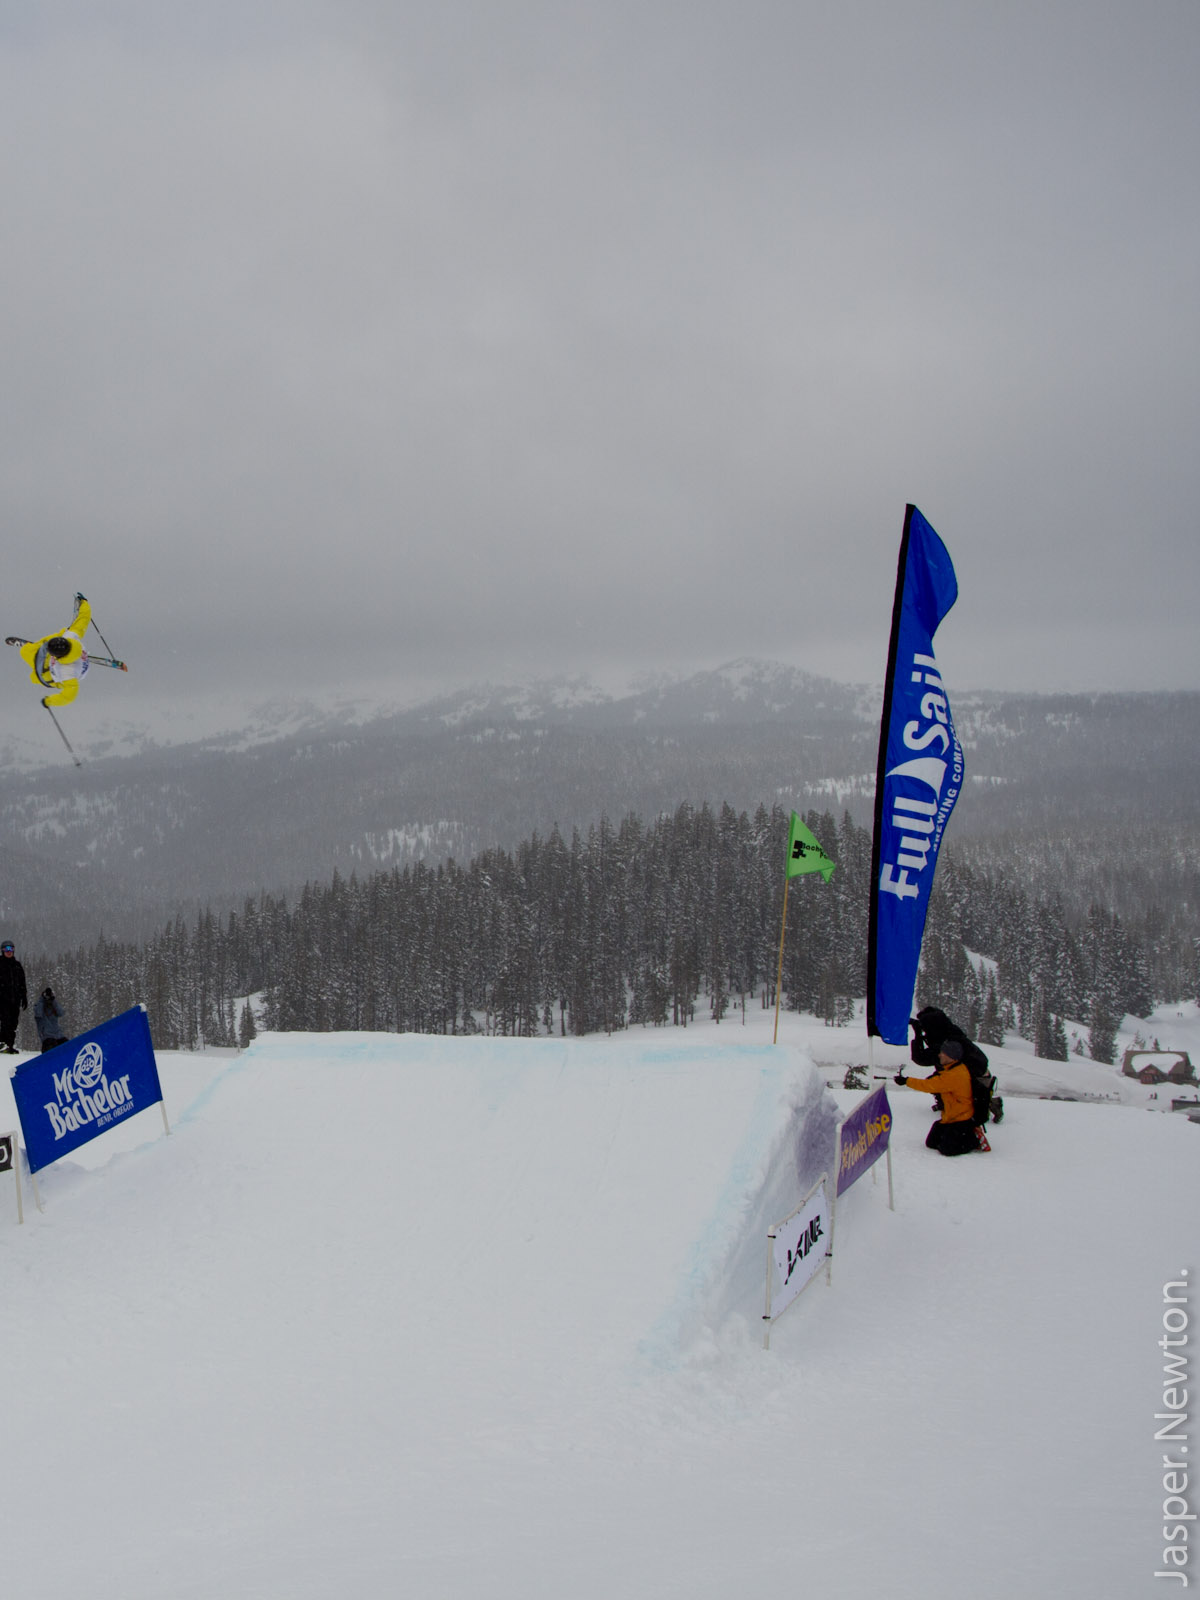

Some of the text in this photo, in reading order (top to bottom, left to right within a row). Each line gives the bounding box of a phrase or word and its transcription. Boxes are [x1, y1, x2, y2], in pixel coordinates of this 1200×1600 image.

[880, 652, 951, 901] Full Sail
[44, 1074, 133, 1141] Bachelor
[52, 1067, 79, 1107] Mt
[112, 1100, 135, 1119] OREGON
